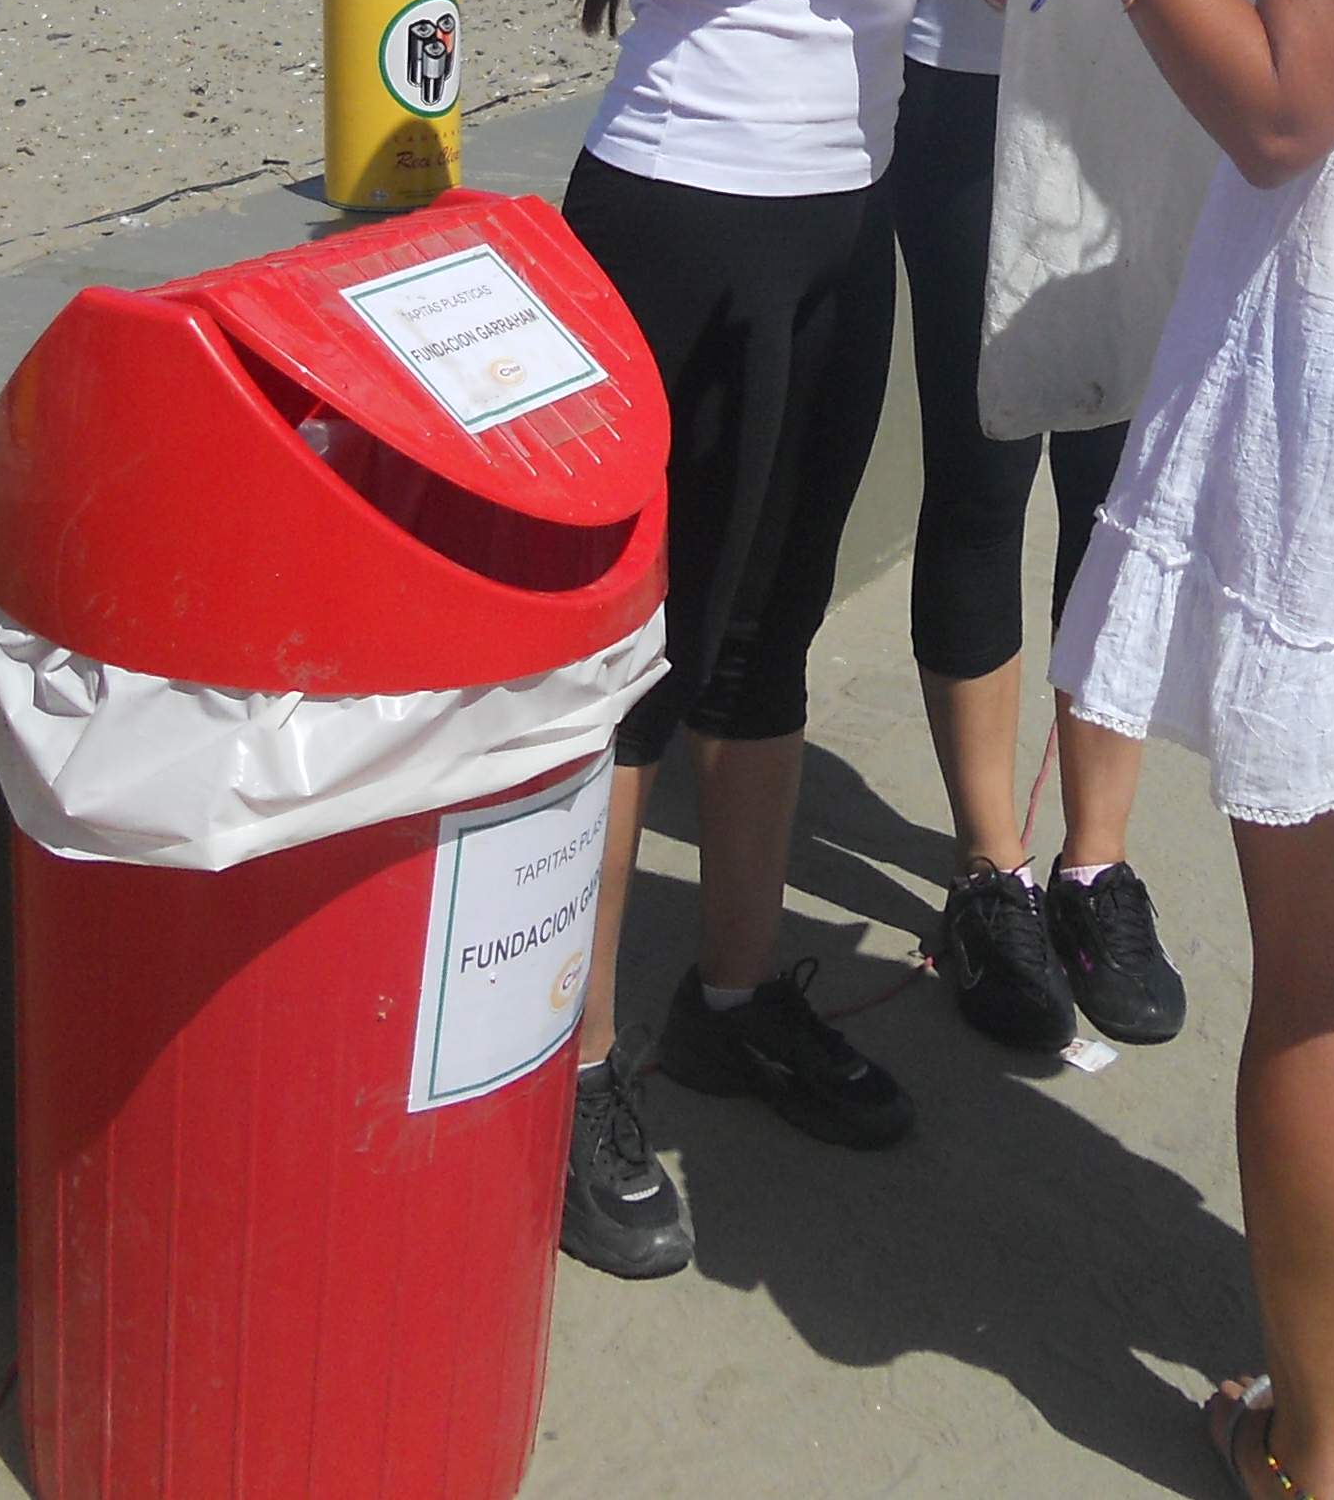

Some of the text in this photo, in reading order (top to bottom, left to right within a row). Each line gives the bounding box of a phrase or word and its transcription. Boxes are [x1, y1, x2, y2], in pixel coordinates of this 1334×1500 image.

[440, 284, 492, 309] PLASTICAS
[410, 307, 540, 364] FUNDACION GARRAHAM
[515, 839, 577, 887] TAPITAS
[460, 896, 578, 974] FUNDACION
